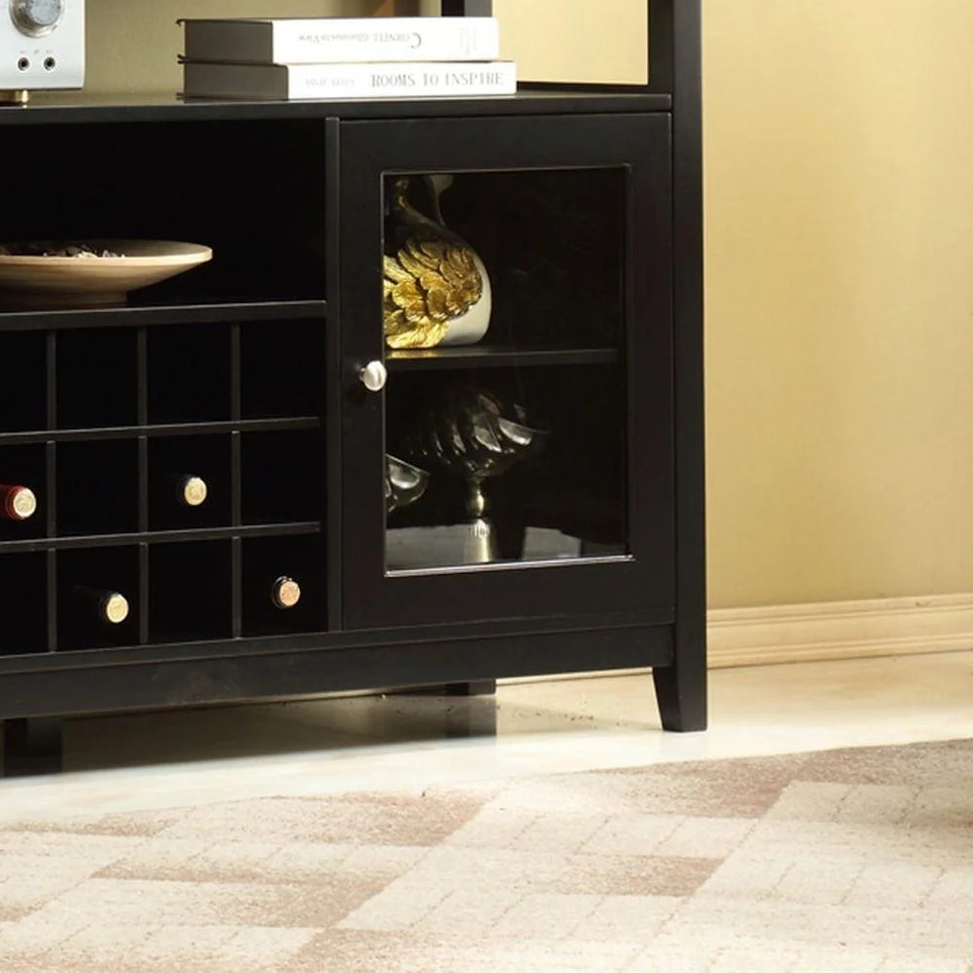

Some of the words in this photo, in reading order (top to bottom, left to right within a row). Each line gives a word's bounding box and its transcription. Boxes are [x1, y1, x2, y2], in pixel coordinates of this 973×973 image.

[371, 73, 416, 88] ROOMS
[423, 73, 439, 87] TO
[445, 71, 504, 86] INSPIRE
